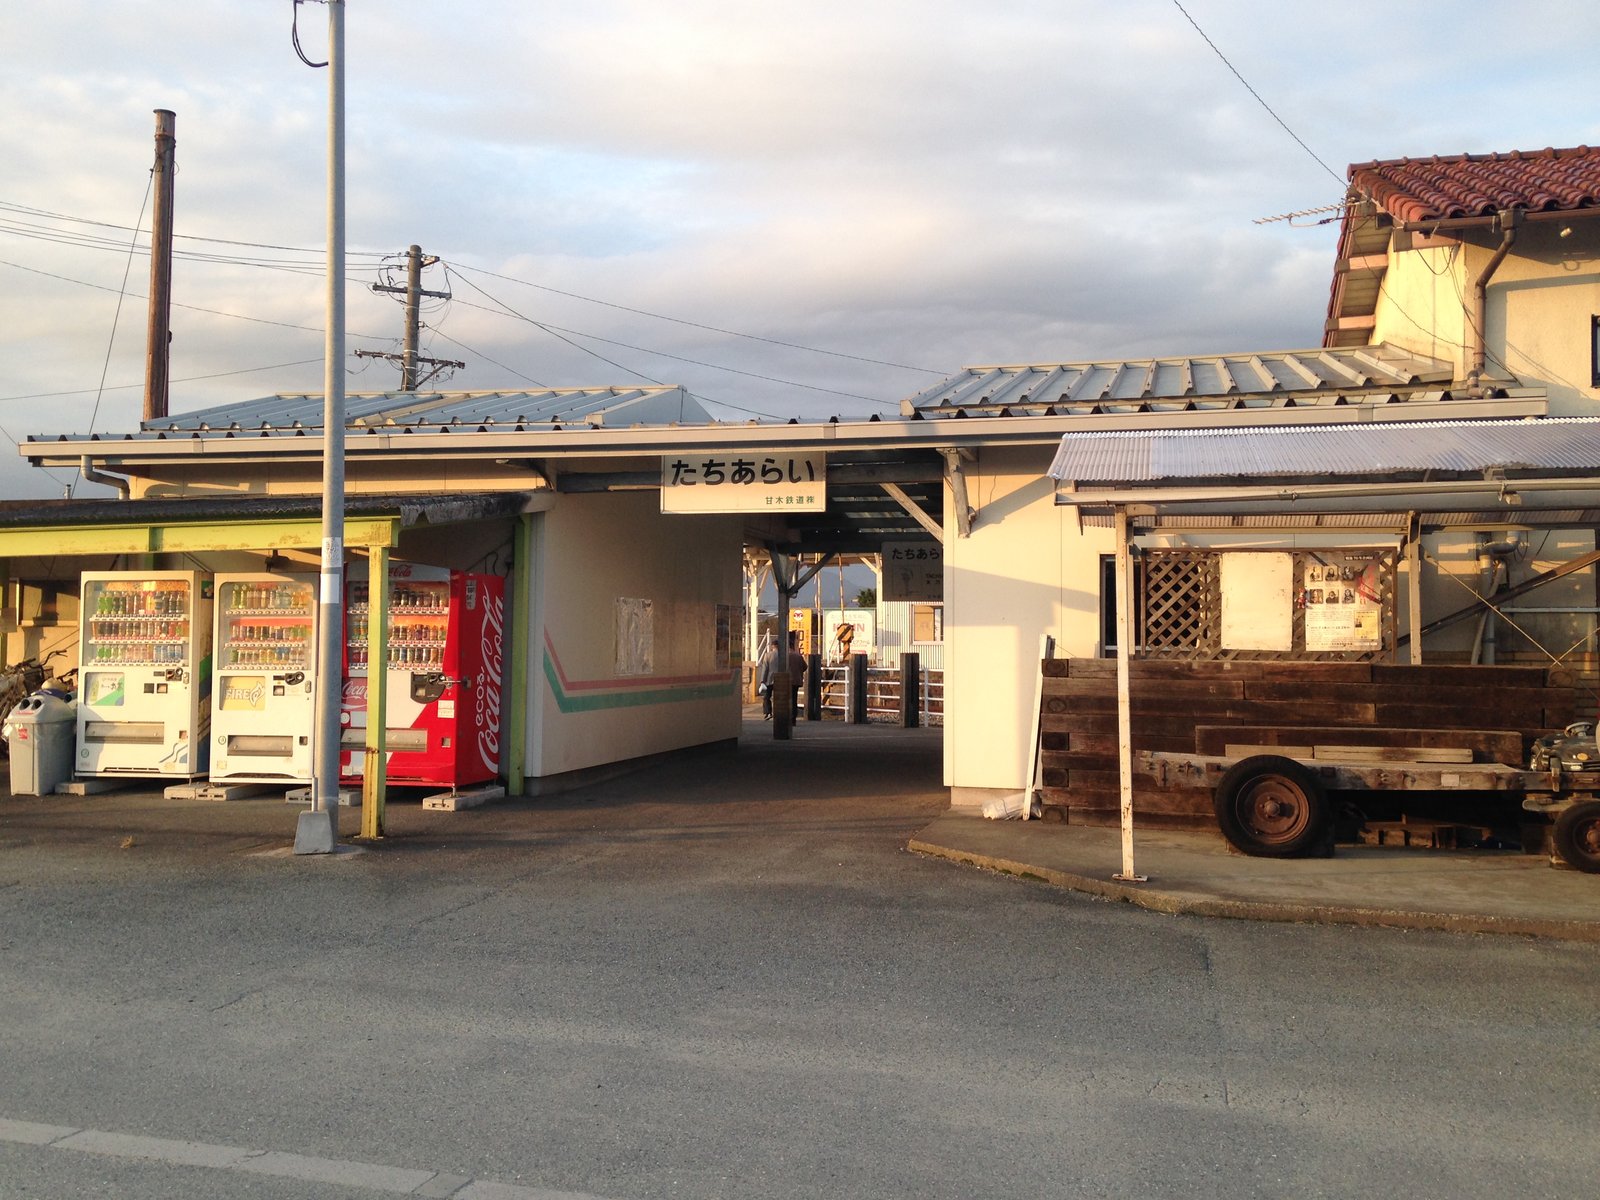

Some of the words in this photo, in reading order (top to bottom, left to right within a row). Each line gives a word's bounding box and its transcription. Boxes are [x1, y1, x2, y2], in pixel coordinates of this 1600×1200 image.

[671, 458, 815, 486] たちあらい
[892, 548, 940, 560] たちあら
[225, 688, 250, 700] FIRE
